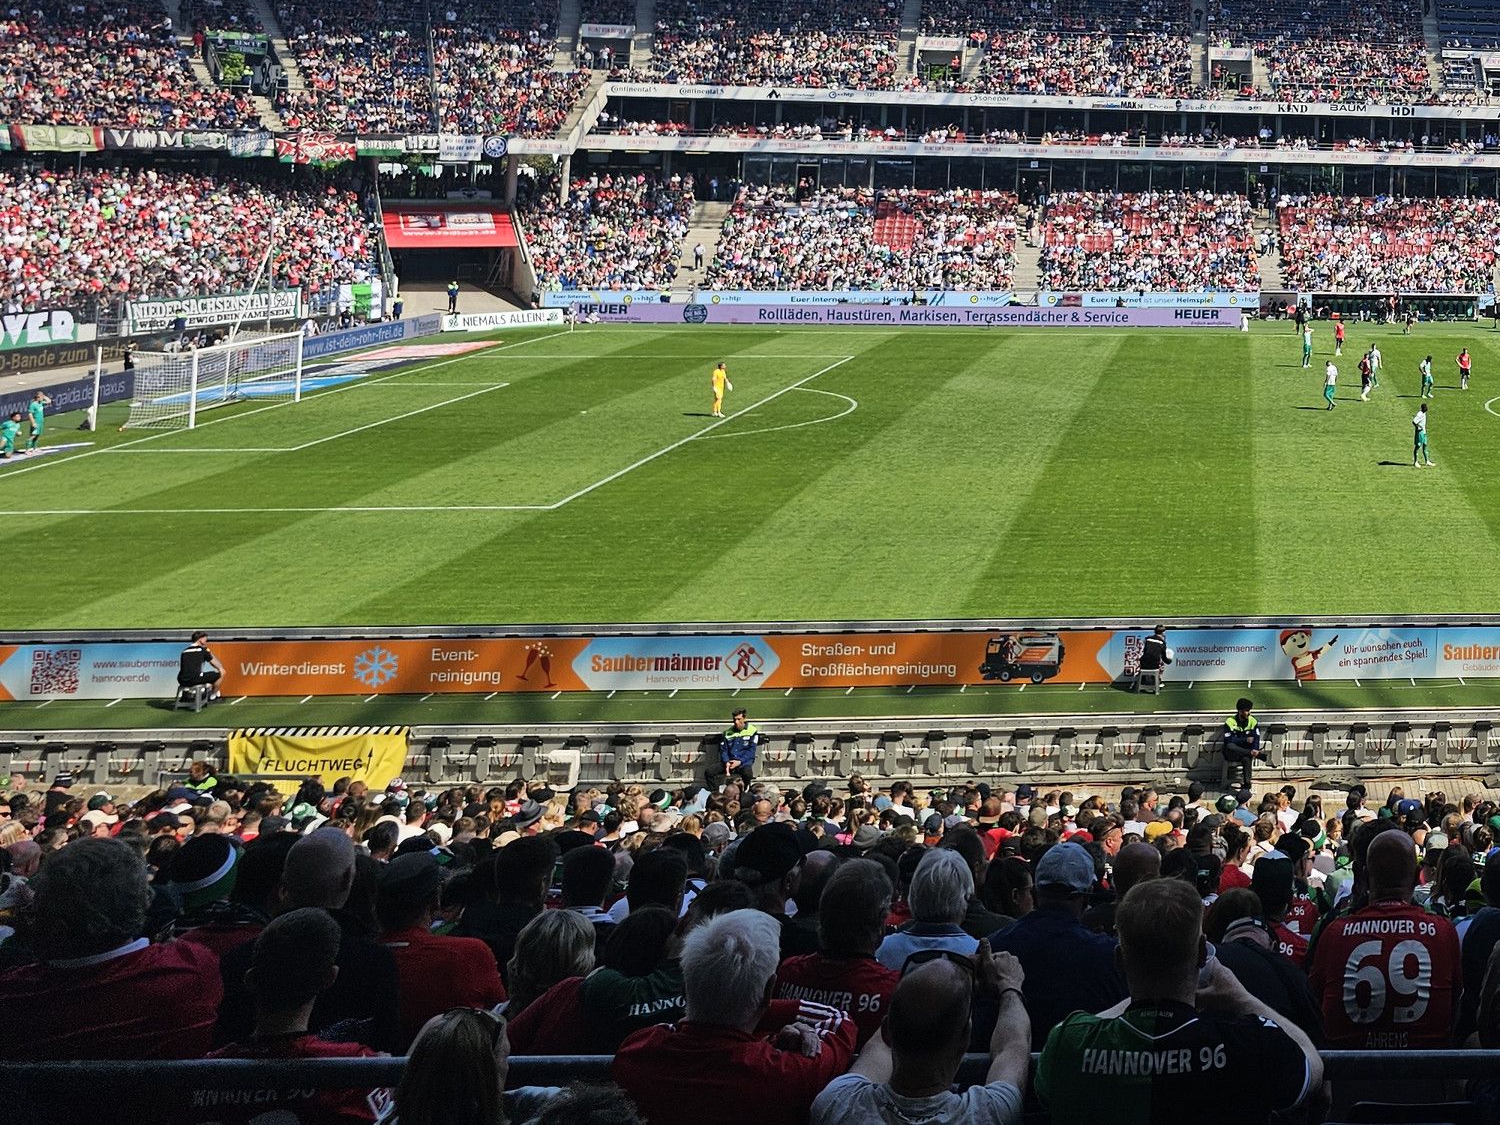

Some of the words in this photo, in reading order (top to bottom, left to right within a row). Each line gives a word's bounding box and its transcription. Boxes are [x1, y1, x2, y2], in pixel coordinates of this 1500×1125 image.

[1329, 103, 1367, 112] BAUM
[1391, 106, 1414, 116] HDI
[790, 296, 810, 304] Euer
[1091, 296, 1108, 304] Euer
[578, 304, 628, 316] HEUER
[759, 308, 823, 322] Rollläden,
[827, 309, 896, 323] Haustüren,
[900, 310, 961, 323] Markisen,
[964, 310, 1068, 323] Terrassendächer
[1071, 311, 1080, 323] &
[1084, 311, 1129, 323] Service
[1174, 309, 1220, 320] HEUER
[462, 314, 507, 327] NIEMALS
[510, 312, 547, 325] ALLEIN!
[59, 348, 88, 365] zum
[801, 642, 865, 656] Straßen-
[869, 641, 896, 656] und
[1175, 644, 1268, 654] www.saubermaenner-
[1343, 643, 1358, 655] Wir
[1403, 637, 1423, 649] euch
[431, 648, 479, 662] Event-
[591, 652, 723, 673] Saubermänner
[1175, 657, 1226, 668] hannover.de
[1338, 656, 1352, 668] ein
[1353, 652, 1404, 669] spannendes
[1405, 648, 1429, 663] Spiel!
[240, 662, 346, 676] Winterdienst
[800, 662, 957, 678] Großflächenreinigung
[91, 672, 150, 684] hannover.de
[429, 669, 501, 685] reinigung
[646, 675, 689, 684] Hannover
[691, 674, 720, 684] GmbH
[263, 757, 364, 772] FLUCHTWEG
[1341, 919, 1415, 937] HANNOVER
[1418, 921, 1437, 937] 96
[1278, 941, 1294, 957] 96
[1342, 938, 1433, 1025] 69
[857, 992, 881, 1013] 96
[1080, 1047, 1193, 1076] HANNOVER
[1199, 1042, 1228, 1073] 96
